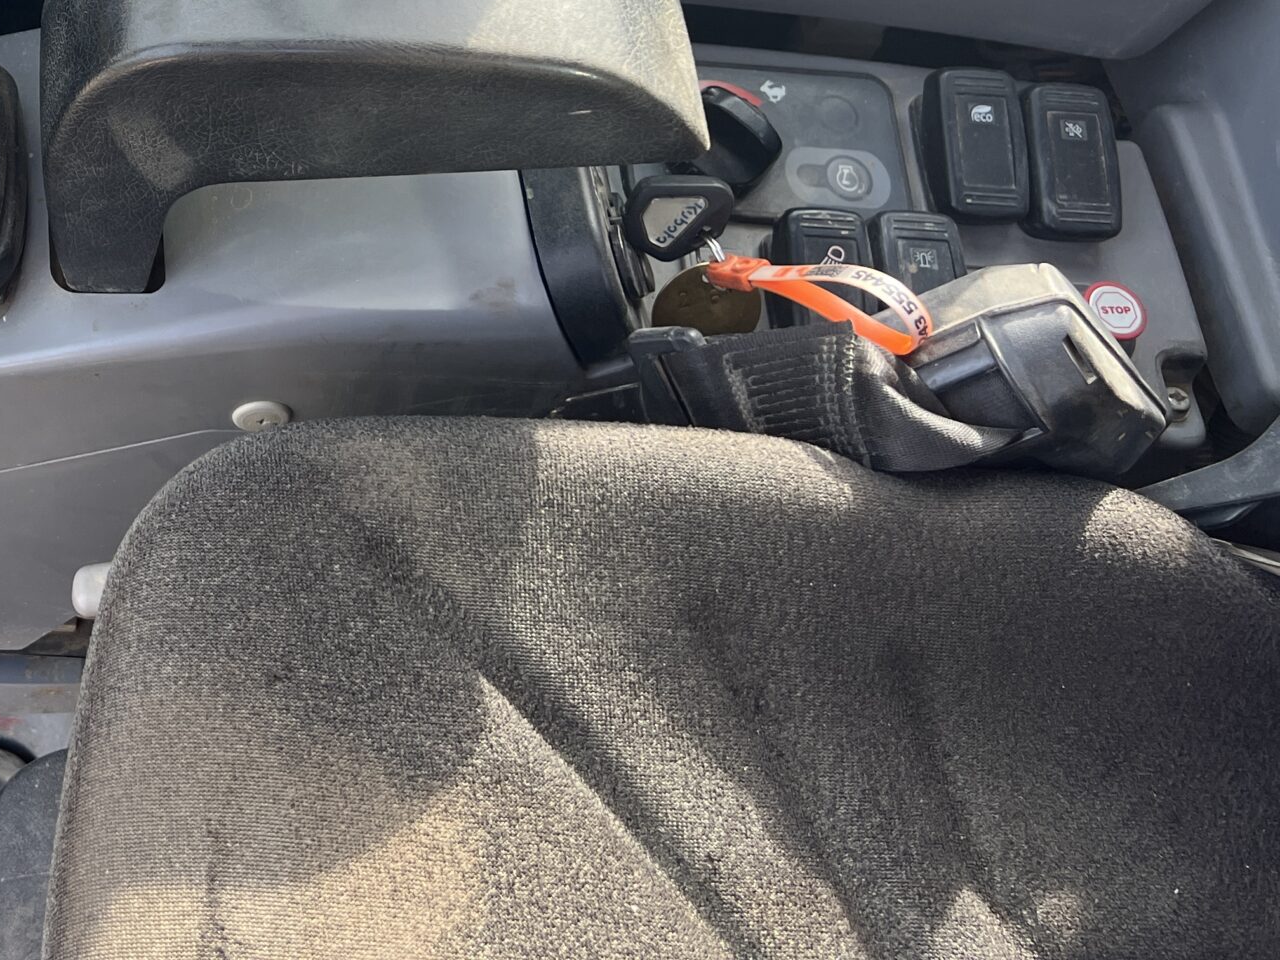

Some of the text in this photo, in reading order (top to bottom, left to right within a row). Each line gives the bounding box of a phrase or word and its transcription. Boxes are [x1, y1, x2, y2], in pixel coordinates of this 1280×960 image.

[973, 110, 994, 123] eco
[656, 202, 702, 244] Kubota
[851, 270, 918, 316] 555445
[1100, 304, 1132, 318] STOP
